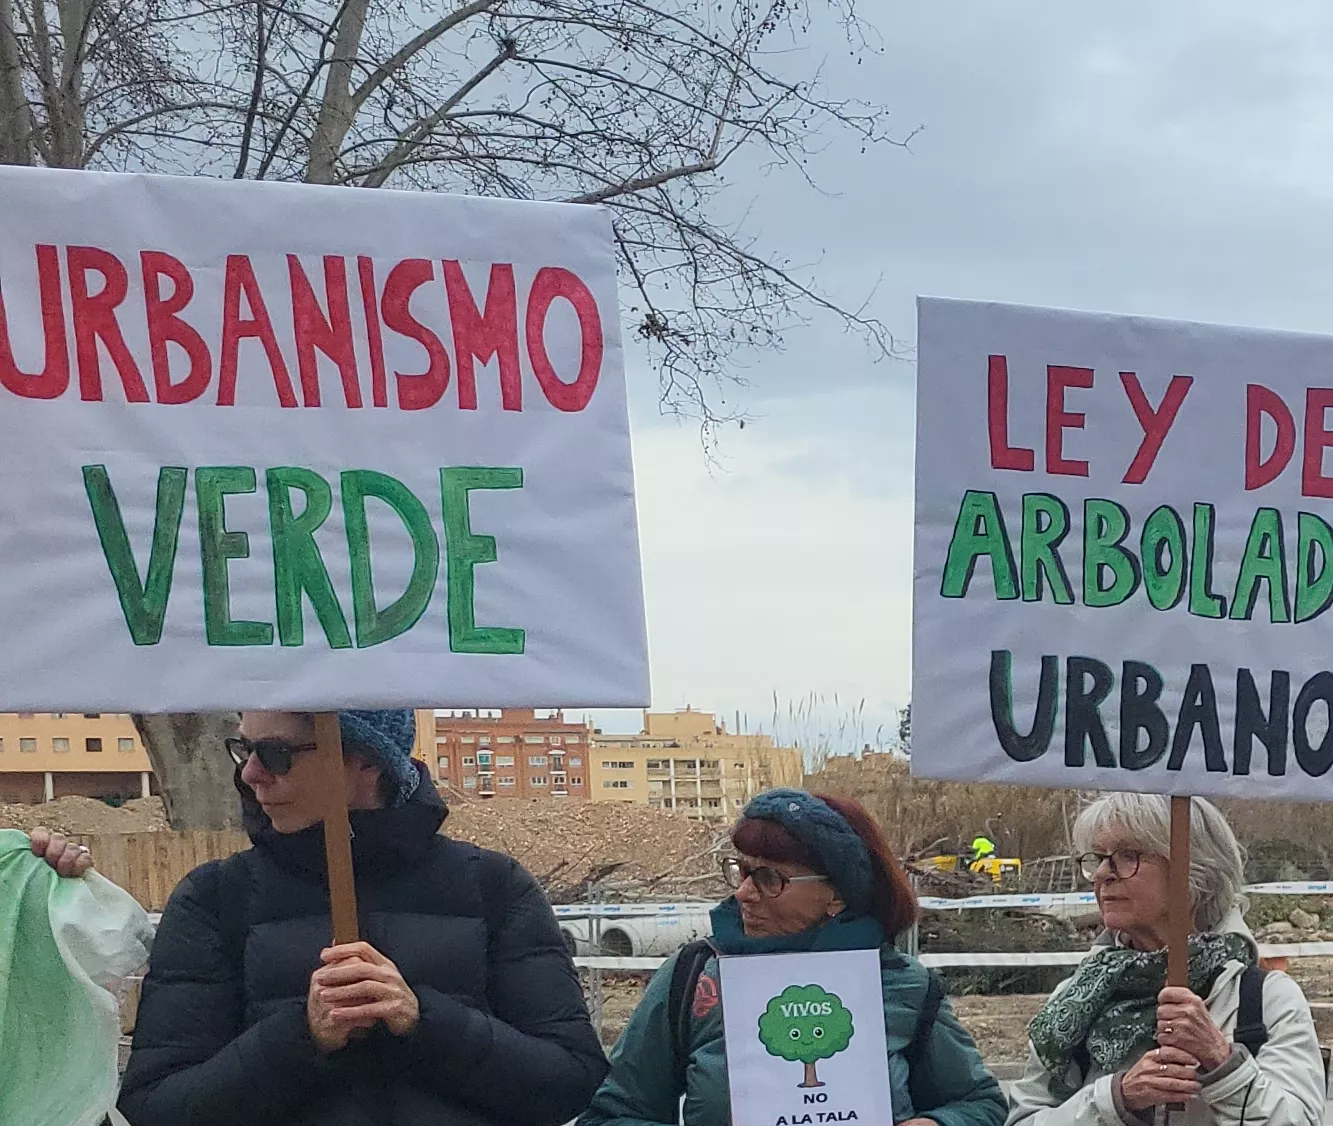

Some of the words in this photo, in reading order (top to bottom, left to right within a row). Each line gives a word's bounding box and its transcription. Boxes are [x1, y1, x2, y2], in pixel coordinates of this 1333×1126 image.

[0, 244, 604, 412] URBANISMO
[987, 355, 1194, 485] LEY
[81, 464, 526, 655] VERDE
[780, 1001, 833, 1018] VIVOS
[775, 1115, 789, 1126] A
[791, 1113, 813, 1125] LA
[815, 1110, 859, 1123] TALA
[803, 1092, 828, 1105] NO
